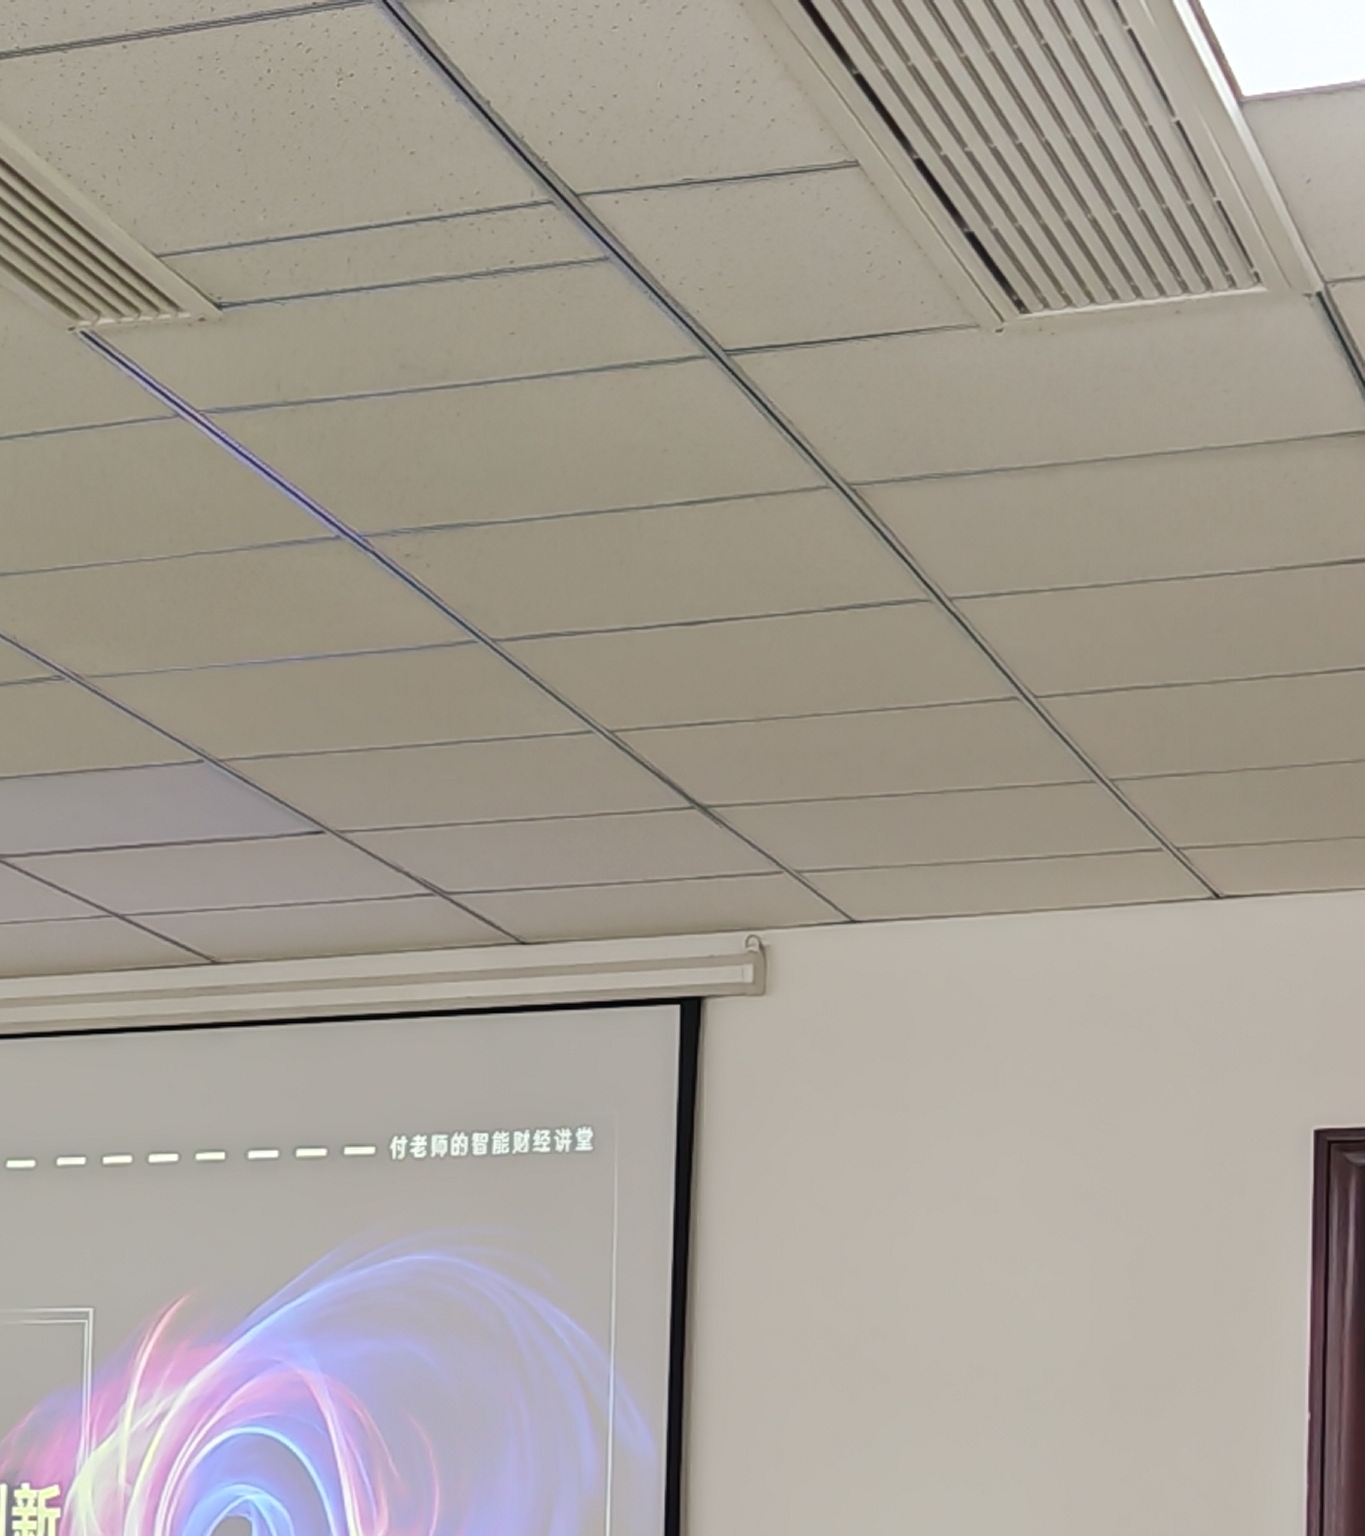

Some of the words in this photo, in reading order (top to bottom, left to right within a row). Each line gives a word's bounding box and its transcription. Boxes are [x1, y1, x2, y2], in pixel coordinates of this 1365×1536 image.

[389, 1126, 594, 1160] 付老师的智能财经讲堂
